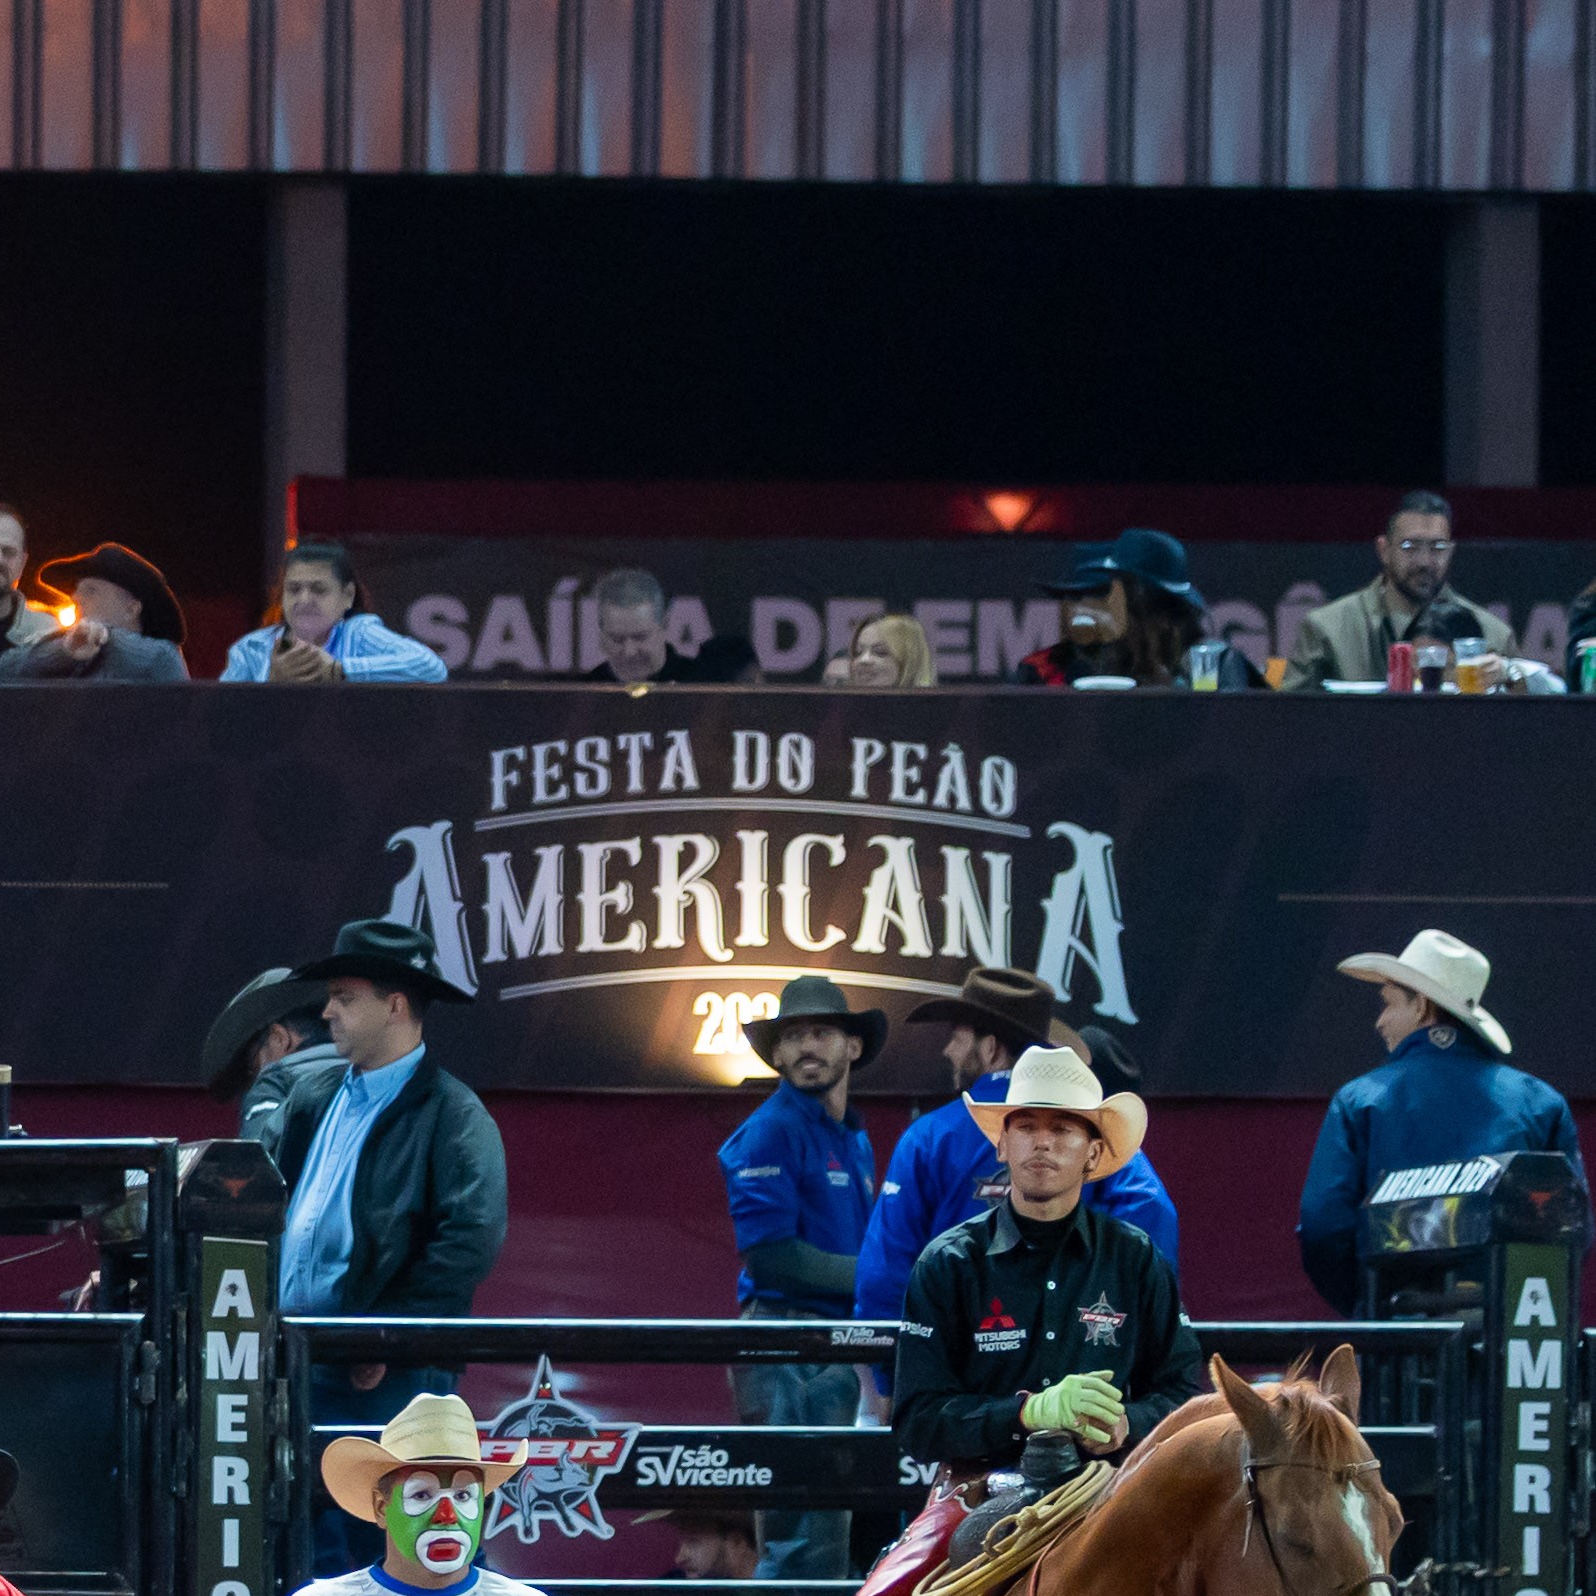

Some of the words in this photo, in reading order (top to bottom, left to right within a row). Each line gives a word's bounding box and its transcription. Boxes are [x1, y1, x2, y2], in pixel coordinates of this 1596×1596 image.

[489, 729, 699, 811] FESTA
[733, 729, 816, 795] DO
[850, 736, 1019, 819] PEÃO
[382, 819, 1138, 1025] AMERICANA
[850, 1336, 894, 1346] vicente
[852, 1325, 874, 1336] são
[978, 1339, 1020, 1352] MOTORS
[480, 1438, 619, 1460] PBR
[682, 1444, 728, 1466] são
[636, 1445, 685, 1487] SV
[676, 1466, 772, 1487] vicente
